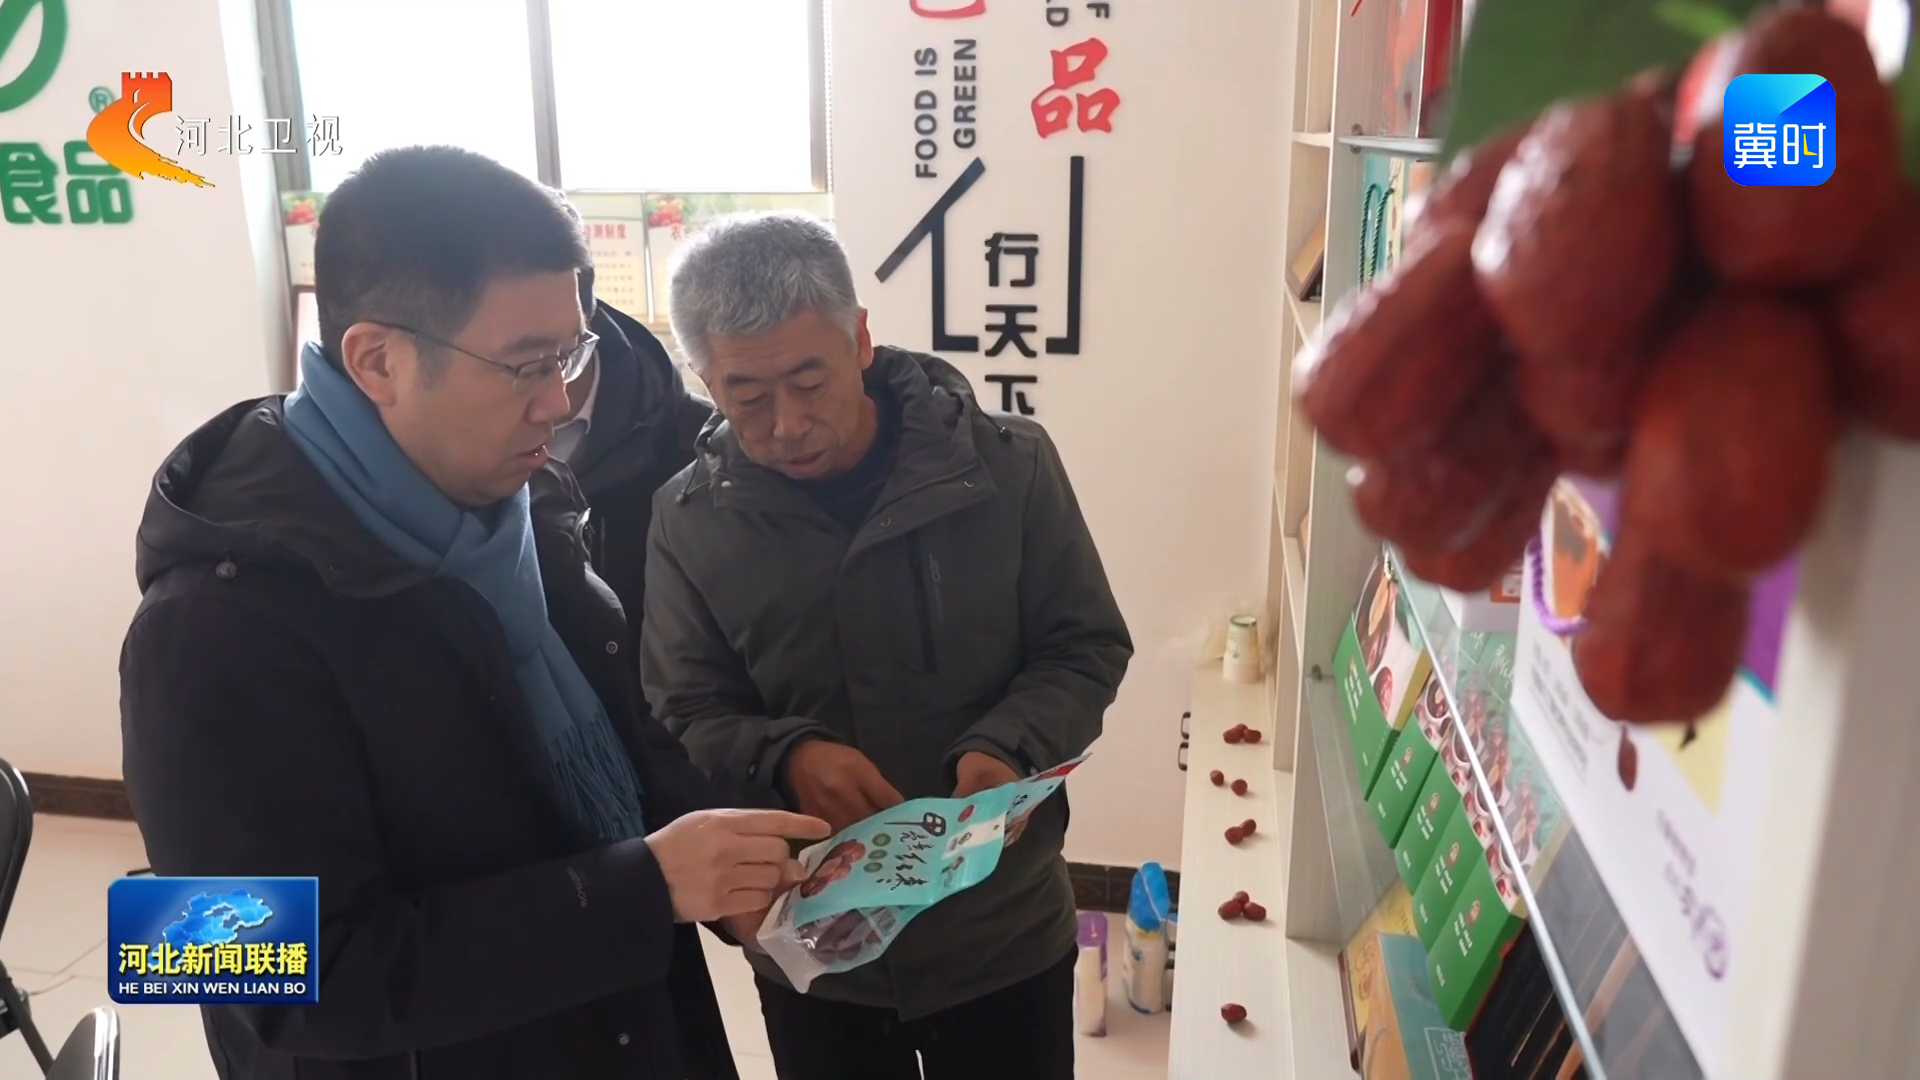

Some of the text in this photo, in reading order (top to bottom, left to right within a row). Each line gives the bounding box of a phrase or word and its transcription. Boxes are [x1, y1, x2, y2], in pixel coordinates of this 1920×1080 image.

[914, 47, 938, 178] FOOD IS
[953, 38, 977, 149] GREEN
[1030, 37, 1121, 139] 品
[984, 231, 1039, 416] 行天下
